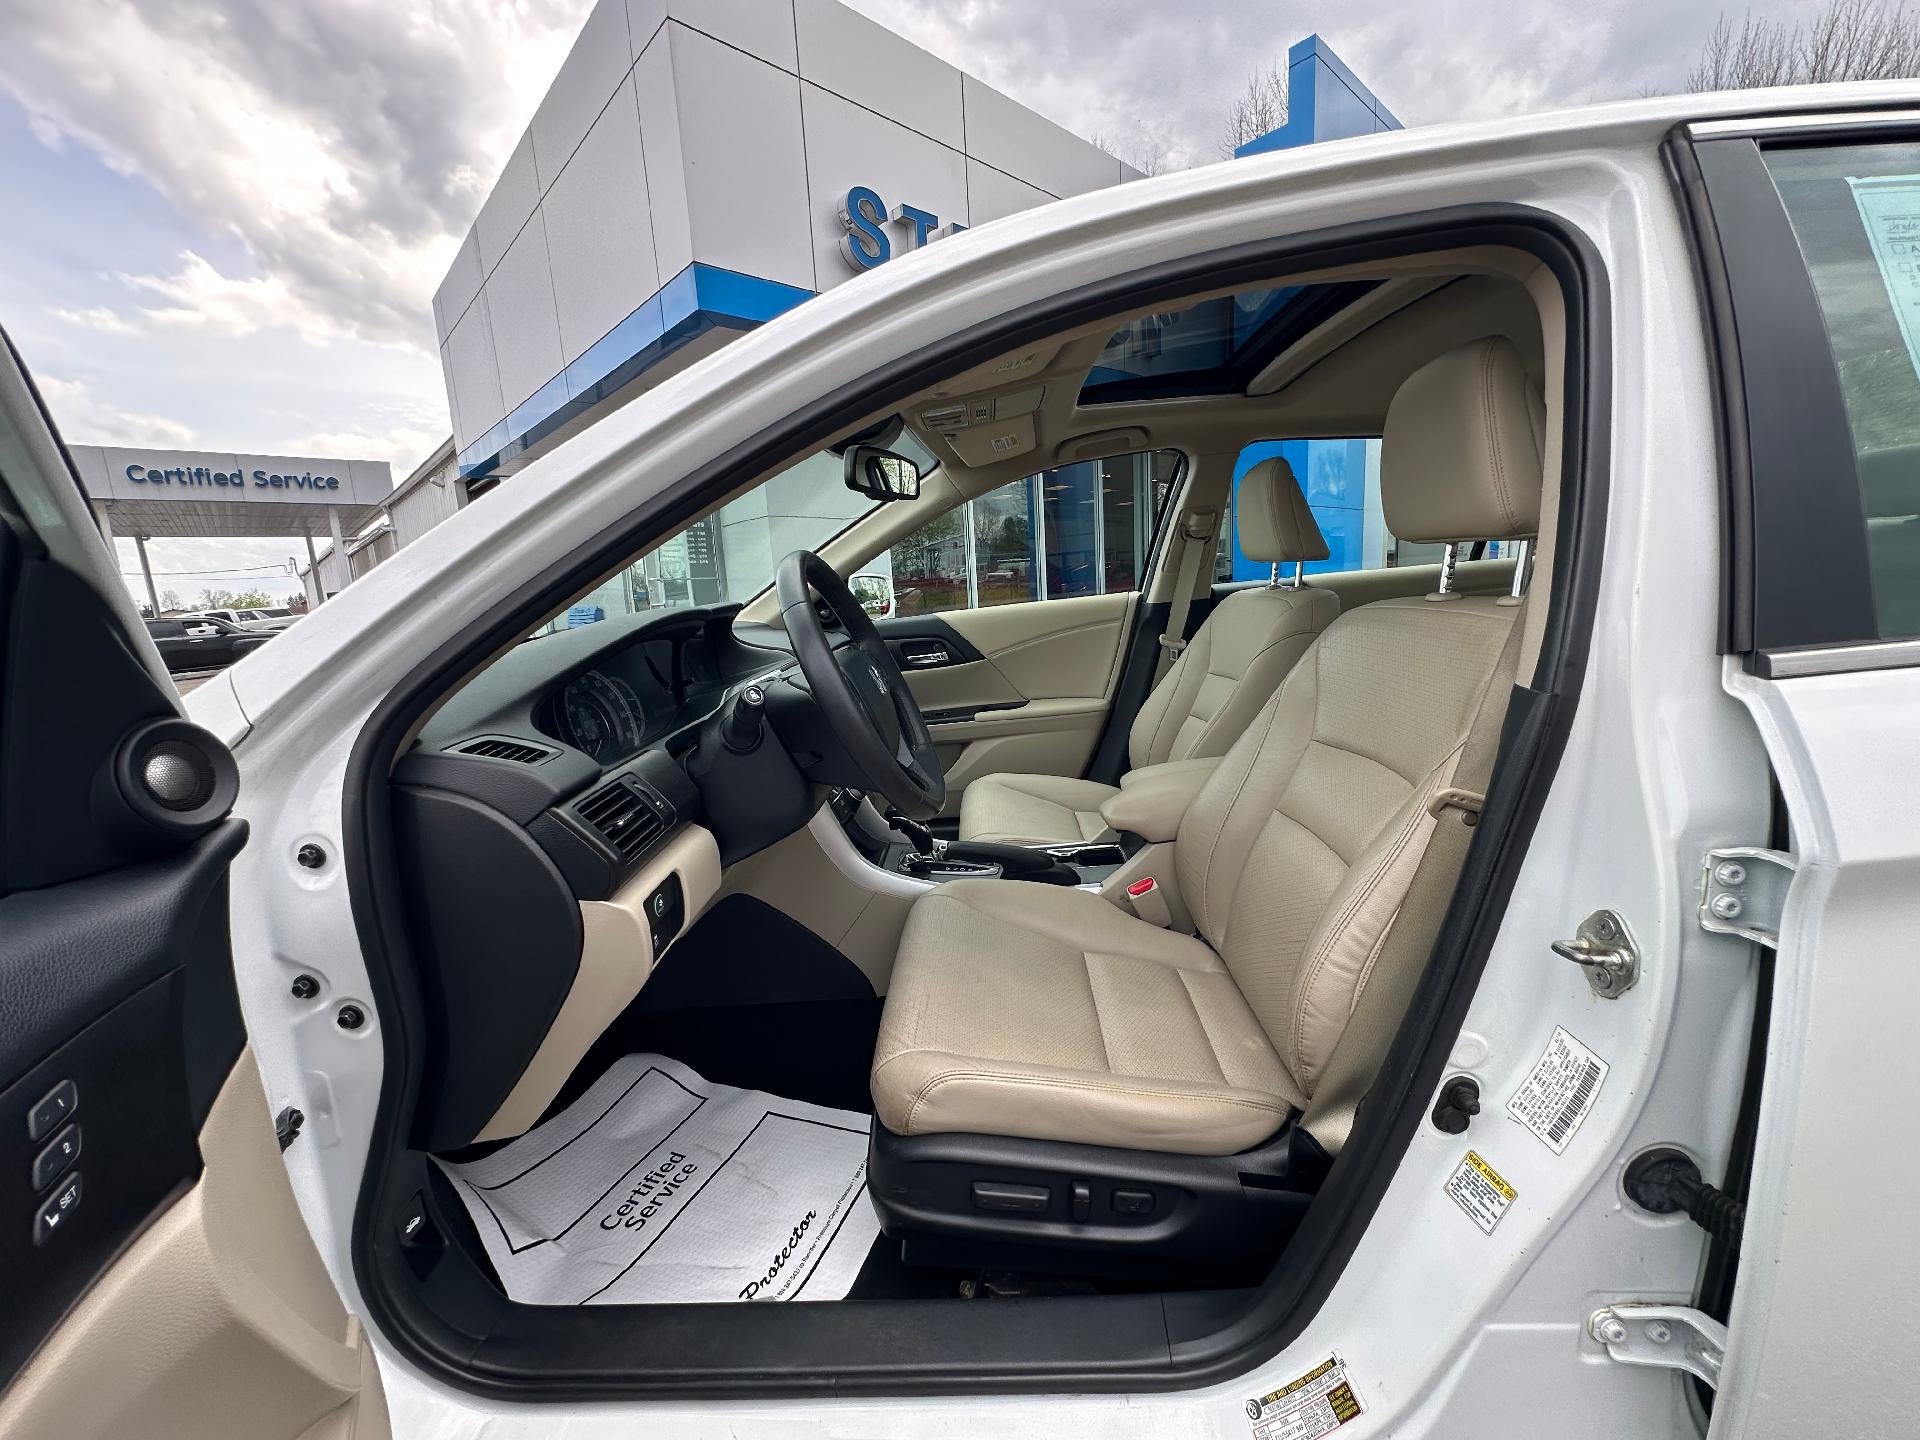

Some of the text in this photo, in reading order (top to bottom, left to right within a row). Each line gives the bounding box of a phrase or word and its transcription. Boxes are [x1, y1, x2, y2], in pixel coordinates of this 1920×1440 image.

[840, 186, 970, 270] ST
[125, 464, 340, 490] Certified Service
[62, 1142, 72, 1154] 2
[59, 1184, 78, 1209] SET
[600, 1151, 687, 1231] Certified
[624, 1163, 698, 1232] Service
[738, 1210, 817, 1300] Protector
